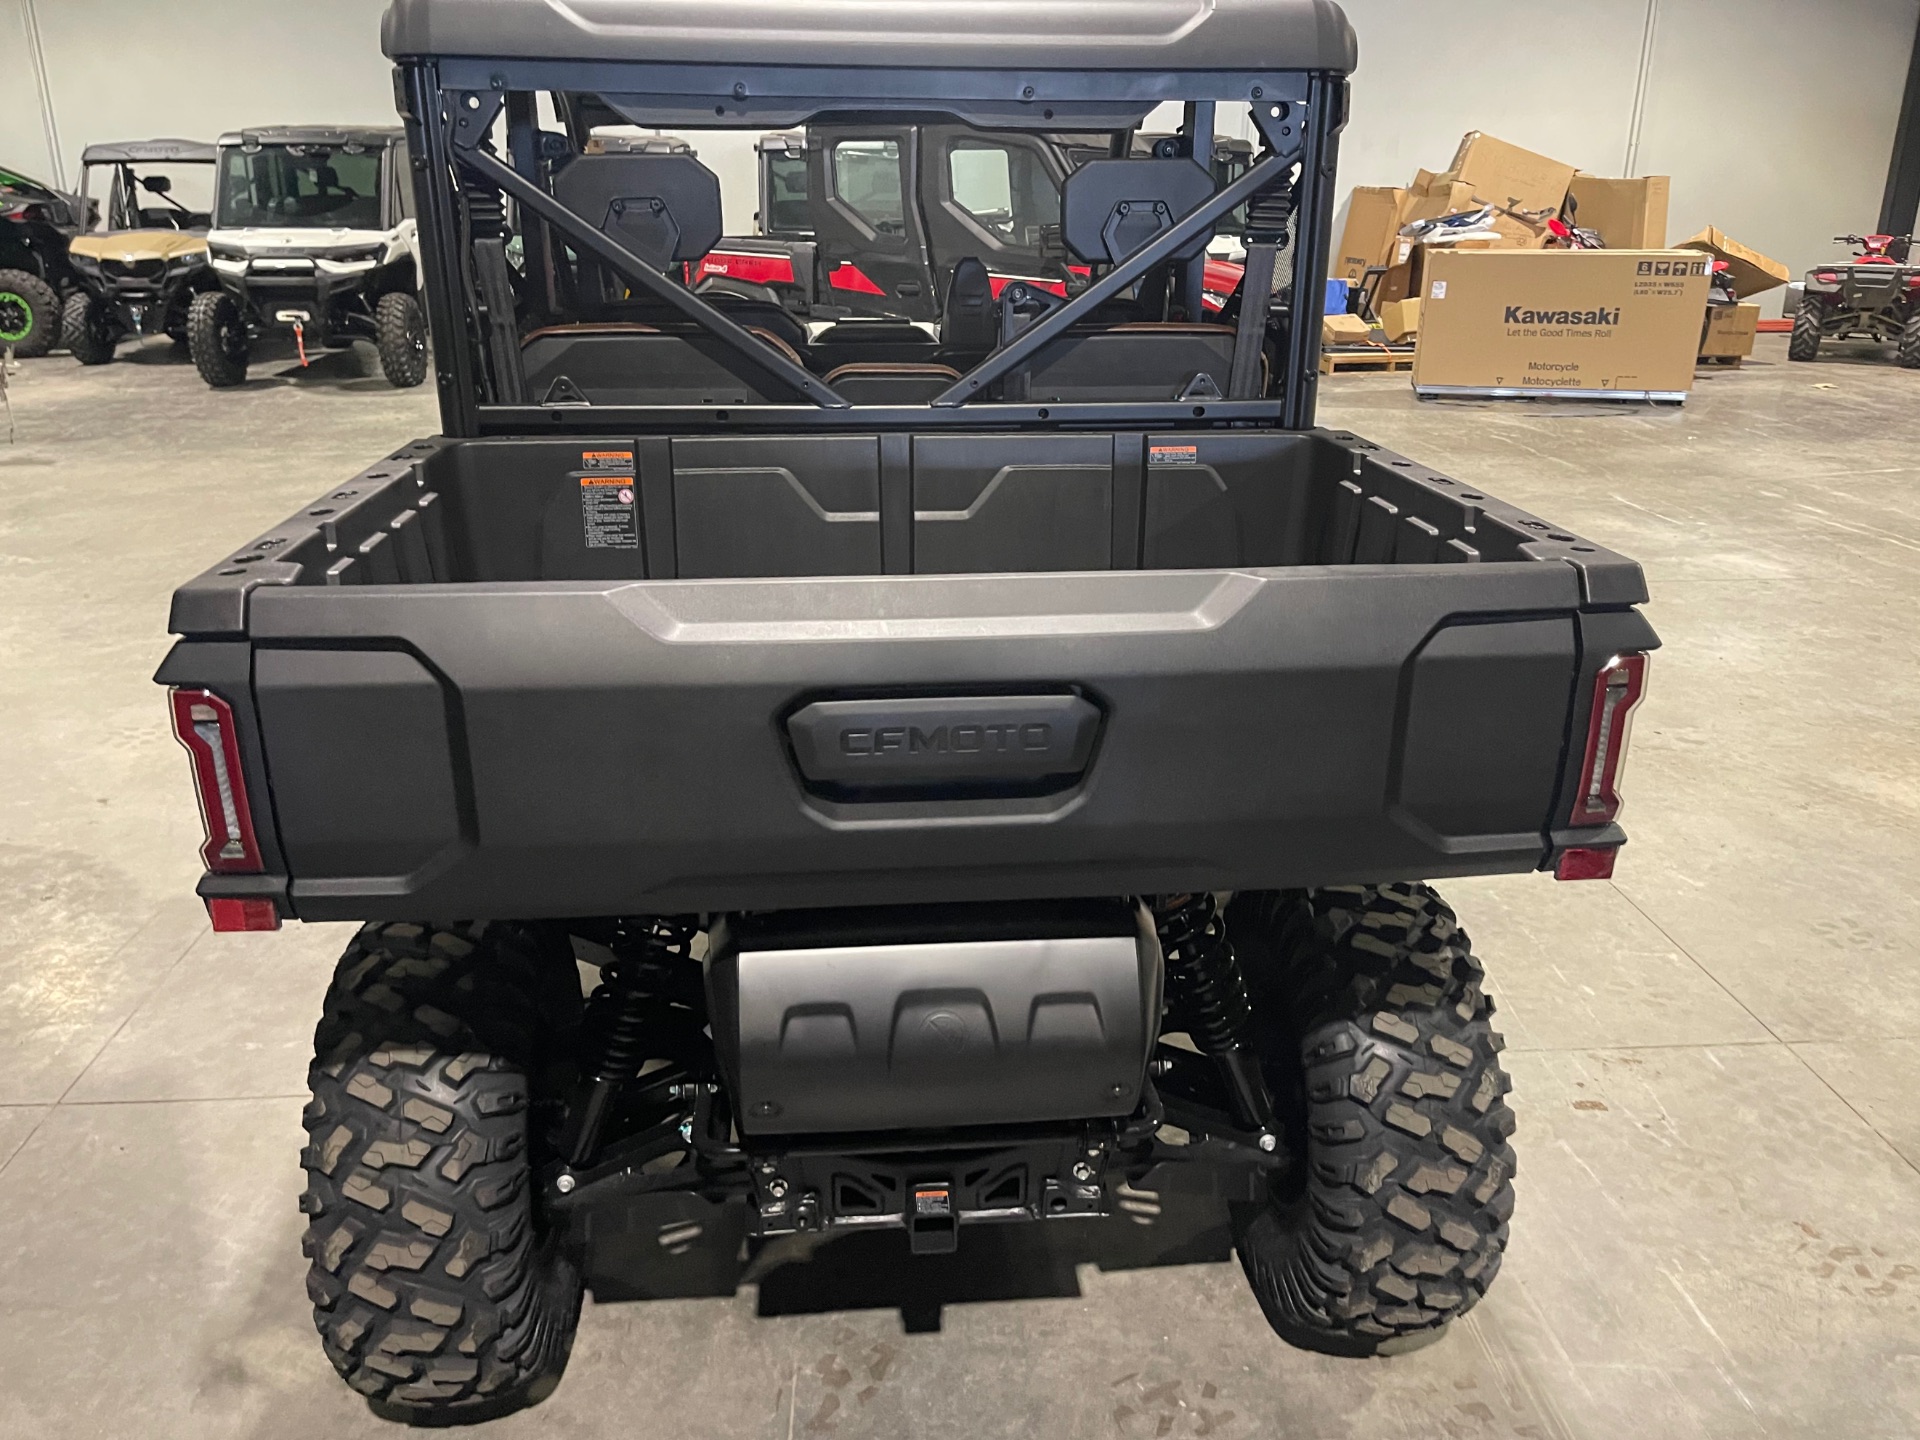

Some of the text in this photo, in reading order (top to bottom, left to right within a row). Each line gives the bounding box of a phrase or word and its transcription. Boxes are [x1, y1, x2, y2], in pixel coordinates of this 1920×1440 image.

[1504, 306, 1620, 325] Kawasaki
[1507, 328, 1612, 338] Let the Good Times Roll
[1528, 362, 1579, 372] Motorcycle
[1522, 376, 1582, 387] Motocyclette
[839, 723, 1052, 755] CFMOTO
